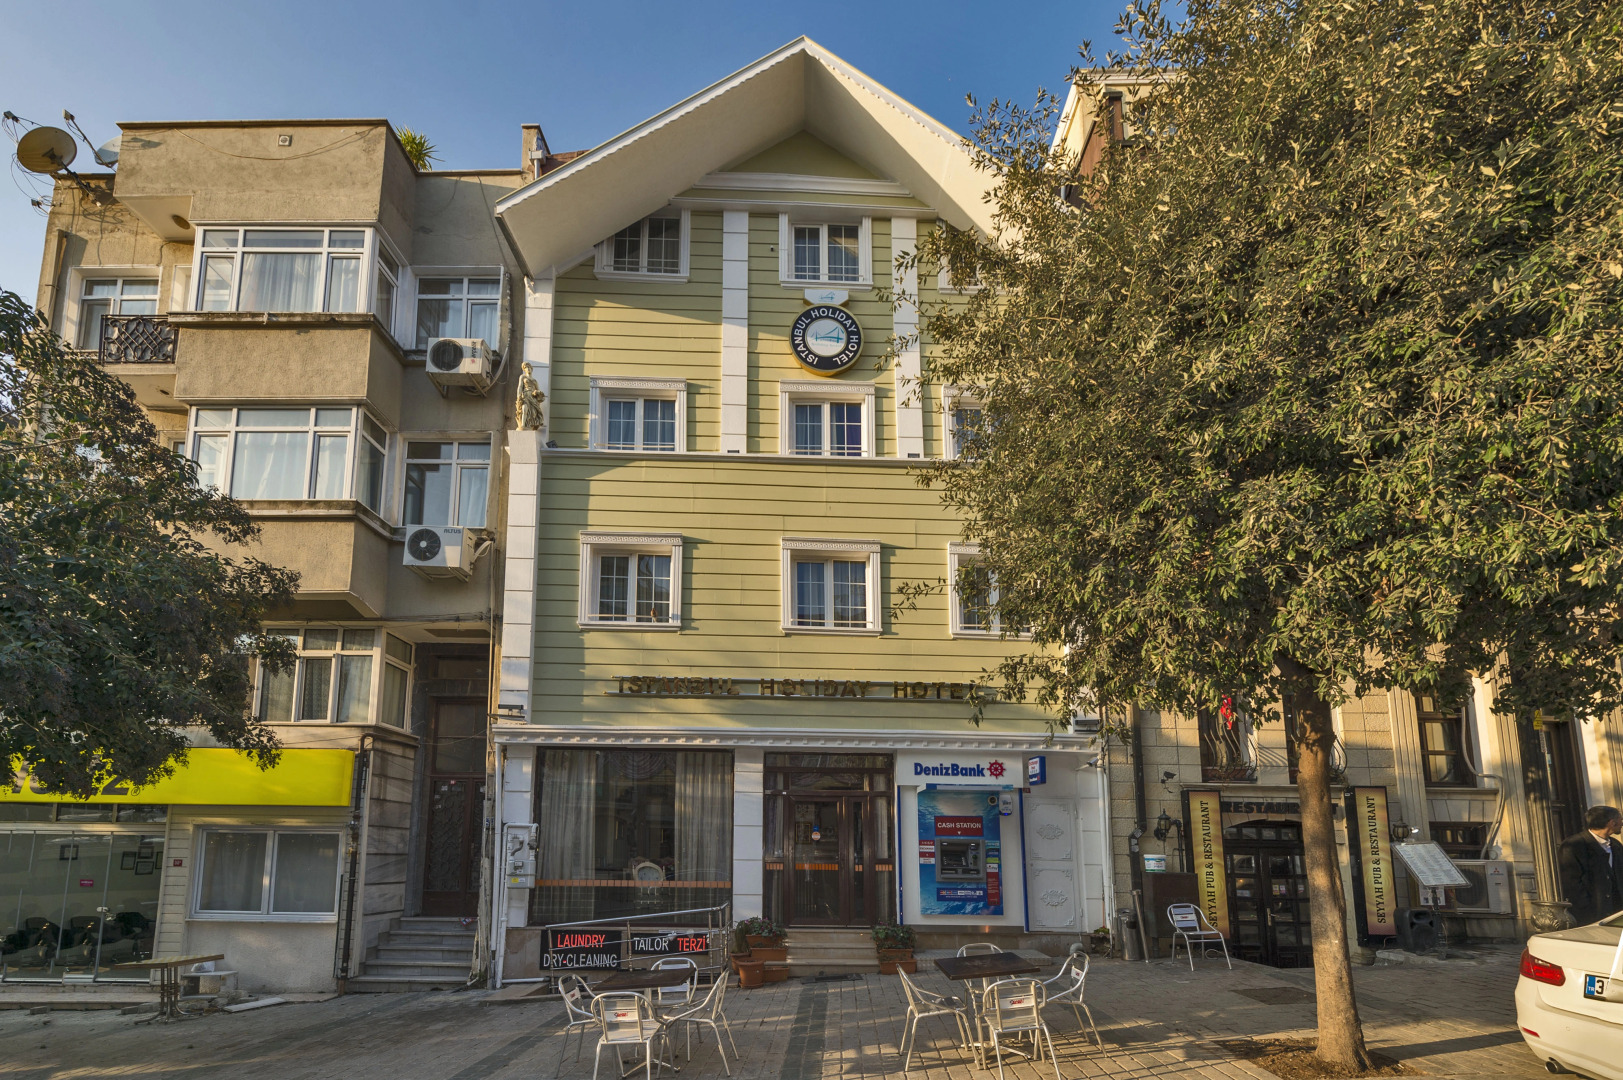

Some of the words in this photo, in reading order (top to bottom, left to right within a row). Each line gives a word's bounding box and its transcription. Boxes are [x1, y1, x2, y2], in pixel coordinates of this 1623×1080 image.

[810, 308, 857, 331] HOLIDAY
[794, 317, 818, 365] ISTANBUL
[833, 336, 858, 365] HOTEL
[760, 678, 871, 697] HOLIDAY
[914, 763, 985, 777] DenizBank
[1221, 802, 1338, 814] RESTAURT
[1200, 800, 1212, 860] RESTAURANT
[1366, 796, 1379, 856] RESTAURANT
[1205, 861, 1214, 870] &
[1206, 871, 1215, 889] PUB
[1373, 866, 1383, 885] PUB
[1207, 891, 1218, 927] SEYYAH
[1375, 887, 1386, 924] SEYYAH
[557, 934, 606, 948] LAUNDRY
[633, 938, 669, 951] TAILOR
[676, 936, 706, 951] TERZİ
[543, 953, 618, 968] DRY-CLEANING
